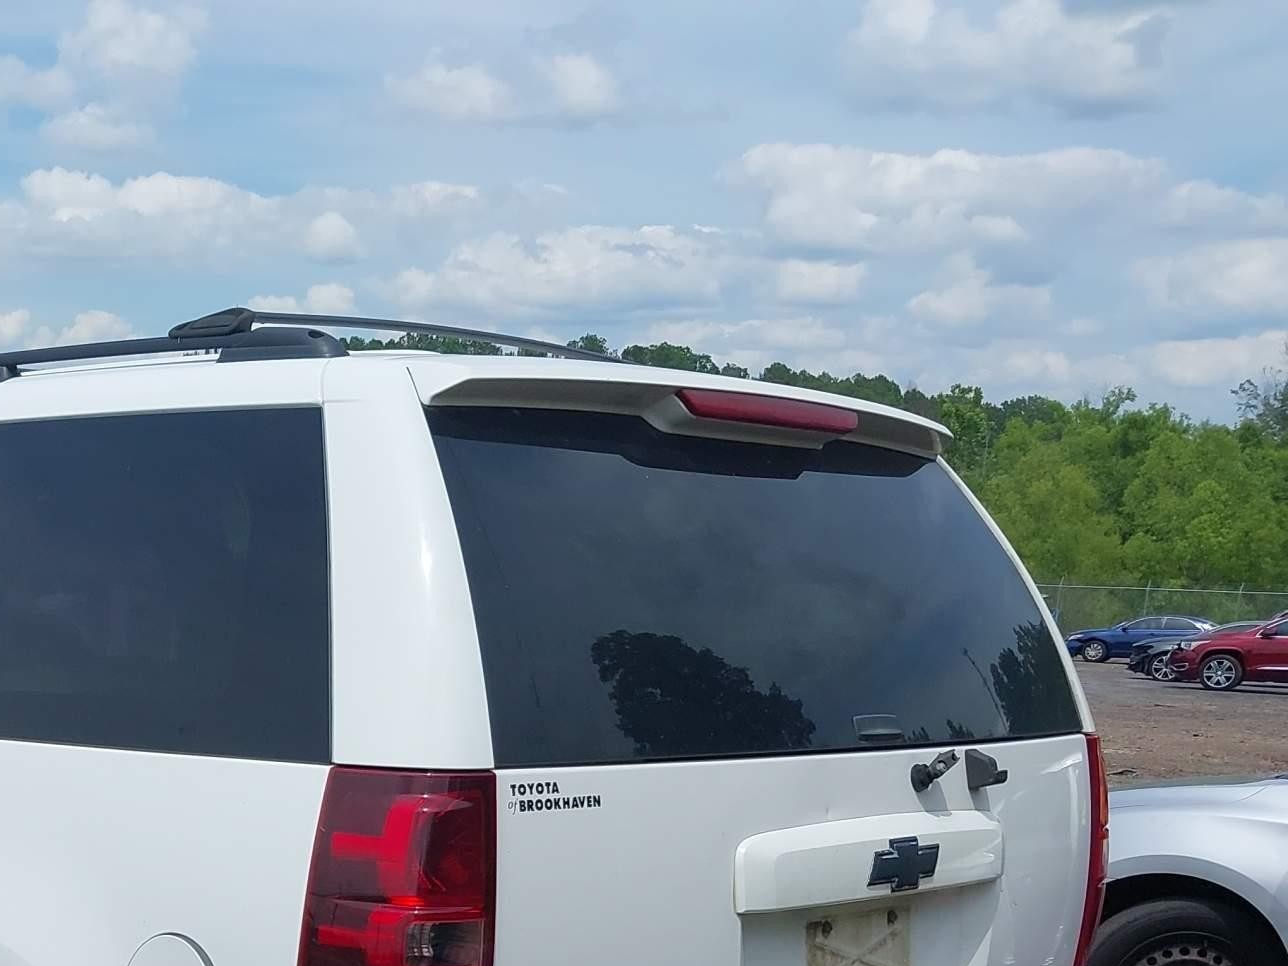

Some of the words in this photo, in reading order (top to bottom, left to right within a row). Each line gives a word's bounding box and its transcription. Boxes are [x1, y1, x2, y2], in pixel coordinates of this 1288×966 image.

[509, 782, 560, 796] TOYOTA
[508, 798, 518, 815] of
[519, 795, 602, 812] BROOKHAVEN
